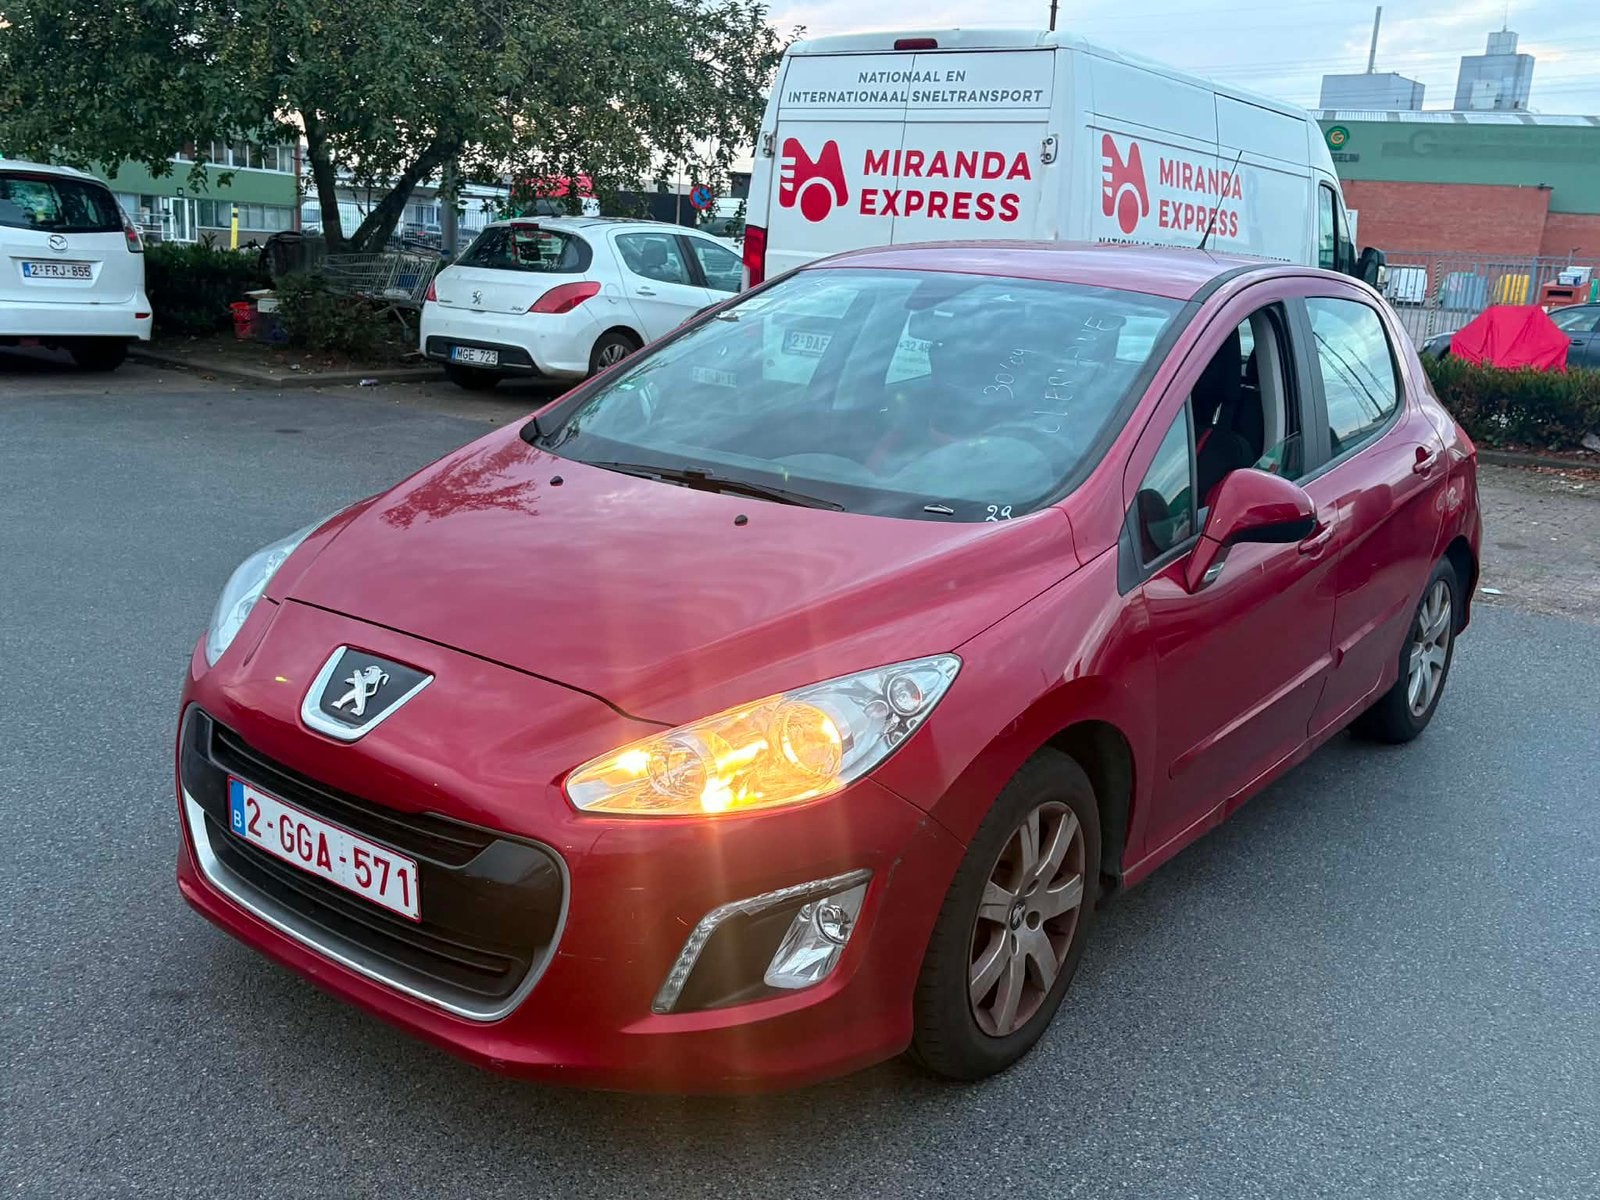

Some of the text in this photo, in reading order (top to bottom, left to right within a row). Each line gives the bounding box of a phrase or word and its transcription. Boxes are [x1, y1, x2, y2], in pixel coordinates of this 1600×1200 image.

[858, 70, 967, 84] NATIONAAL EN
[788, 89, 1043, 103] INTERNATIONAAL SNELTRANSPORT
[864, 149, 1032, 181] MIRANDA
[1159, 157, 1242, 200] MIRANDA
[859, 188, 1021, 222] EXPRESS
[1158, 199, 1239, 238] EXPRESS
[31, 264, 92, 277] 2-FRJ-855
[456, 348, 497, 363] MGE 723
[233, 797, 410, 908] B 2-GGA-571
